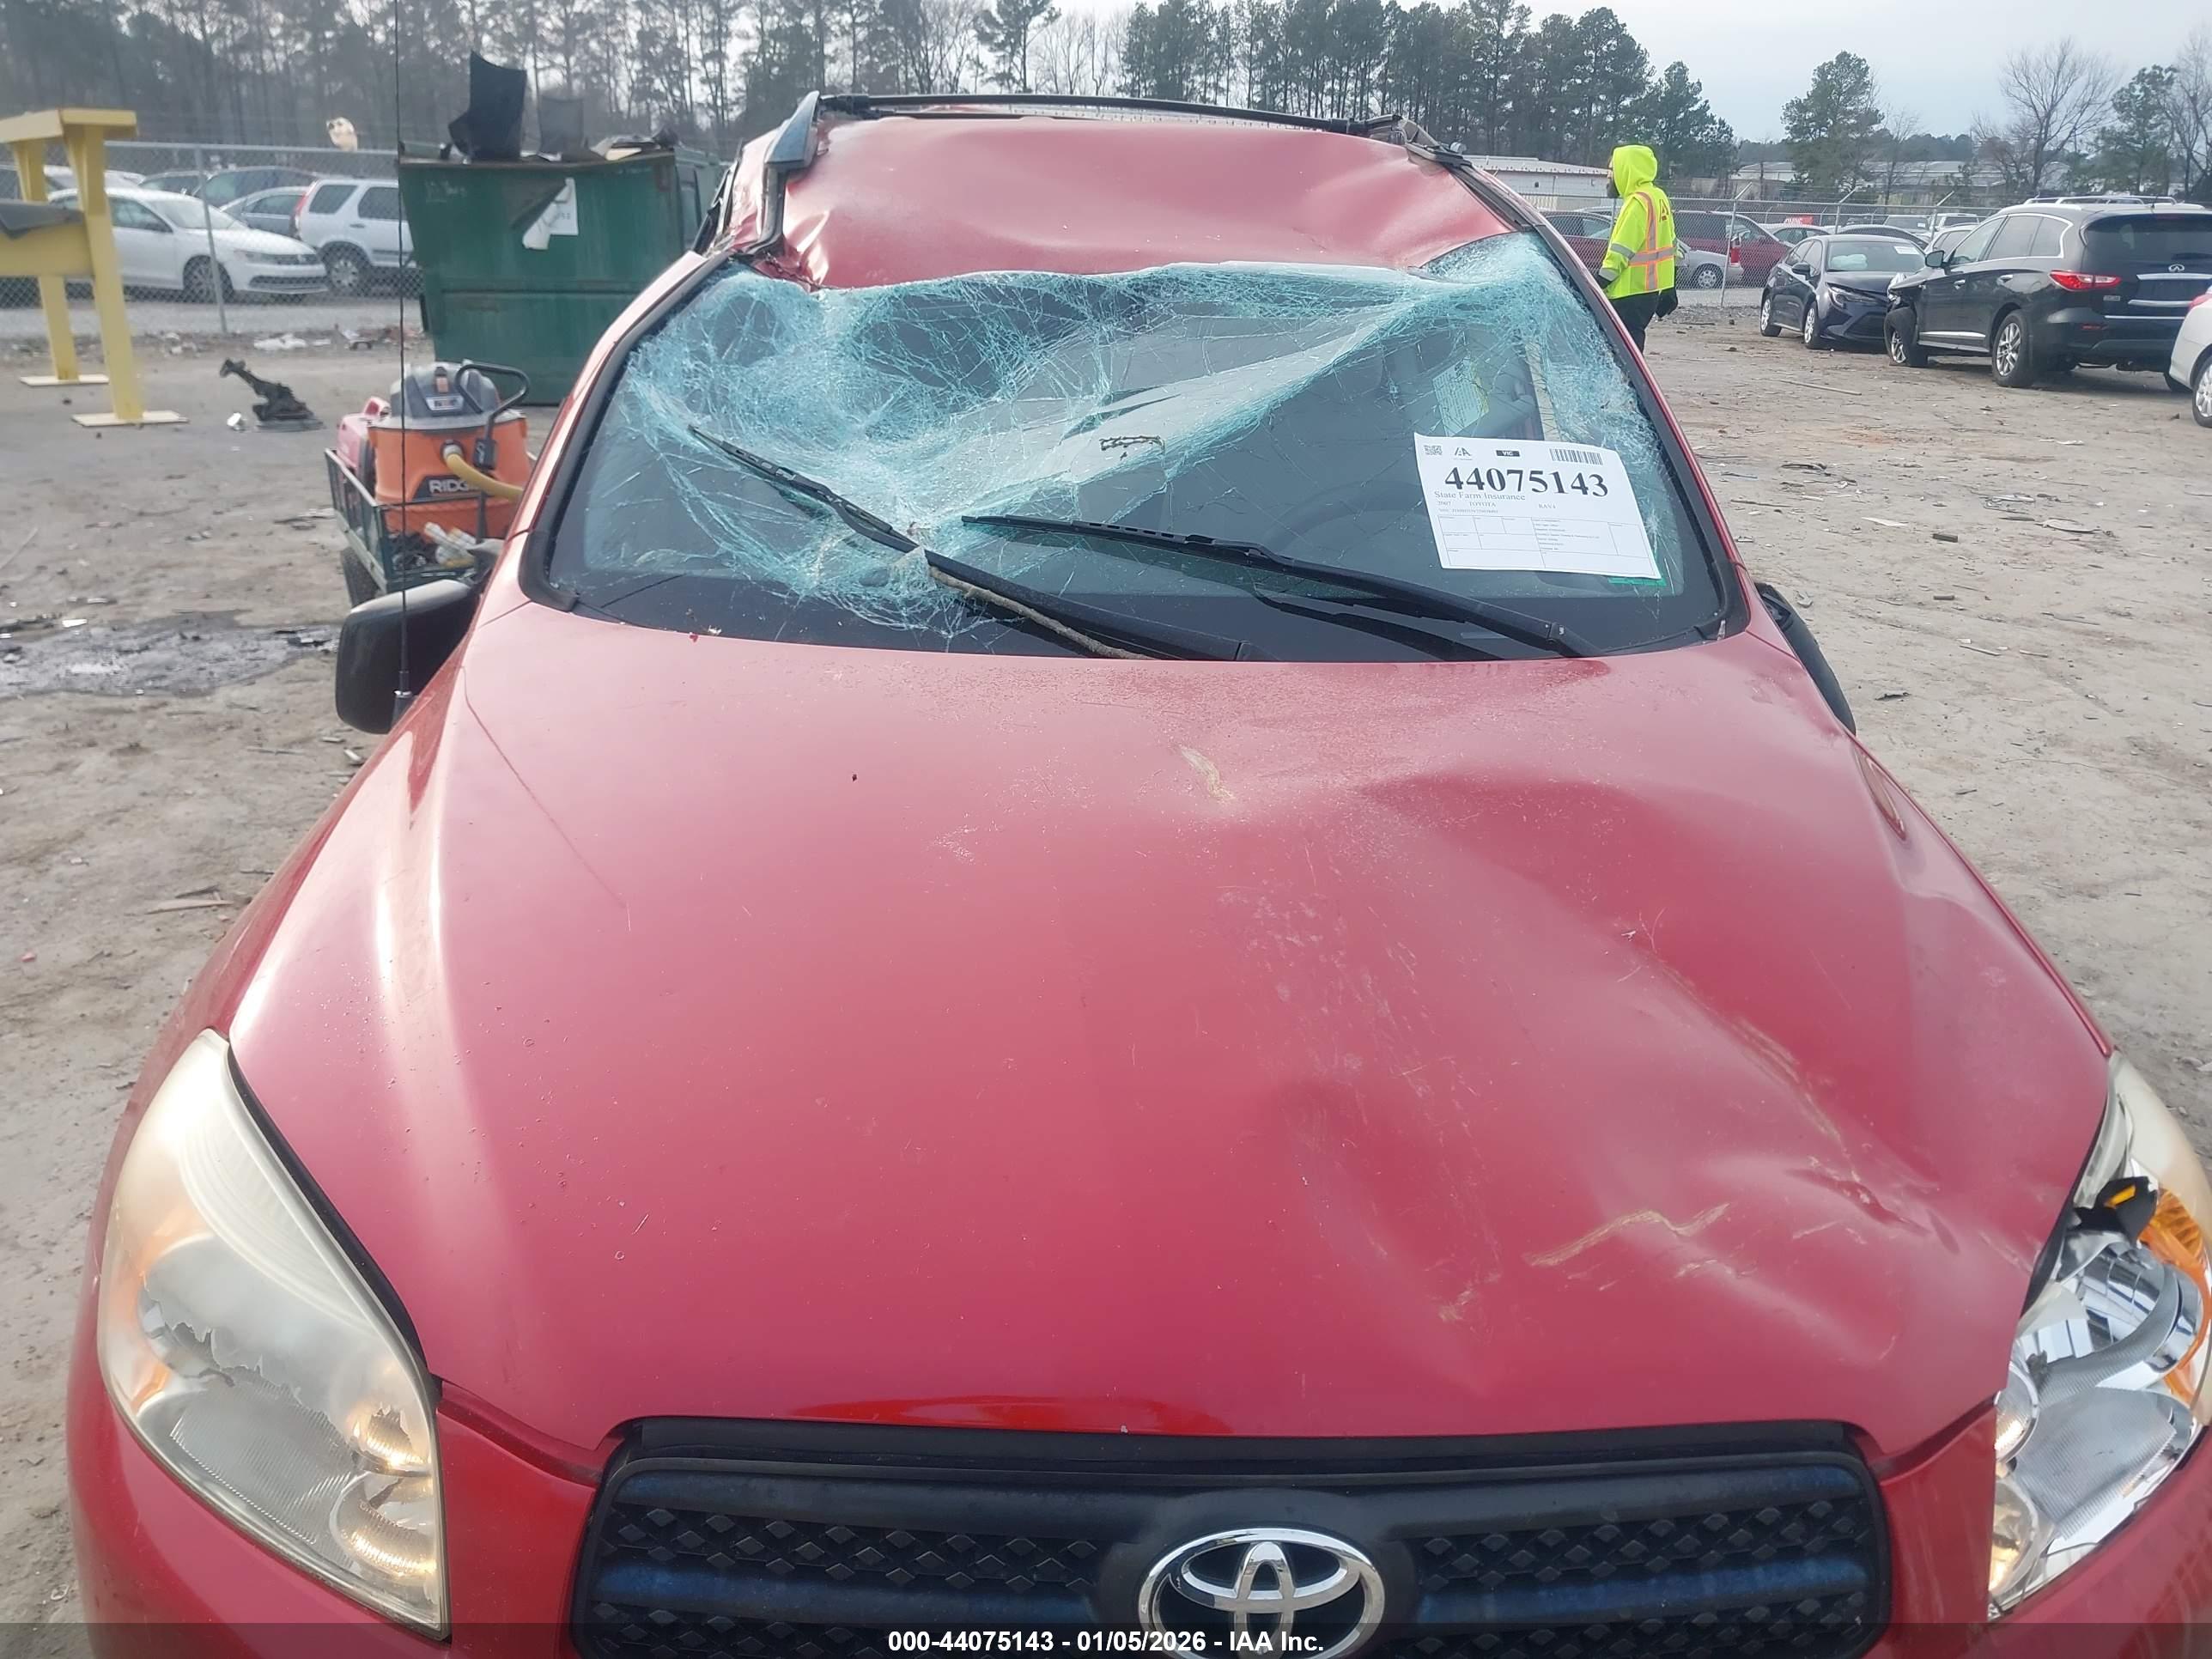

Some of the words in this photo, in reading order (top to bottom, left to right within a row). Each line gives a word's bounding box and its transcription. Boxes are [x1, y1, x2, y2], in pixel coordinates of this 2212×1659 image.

[1444, 466, 1608, 497] 44075143
[1434, 490, 1456, 499] State
[1459, 491, 1481, 500] Farm
[1484, 492, 1526, 501] Insurance
